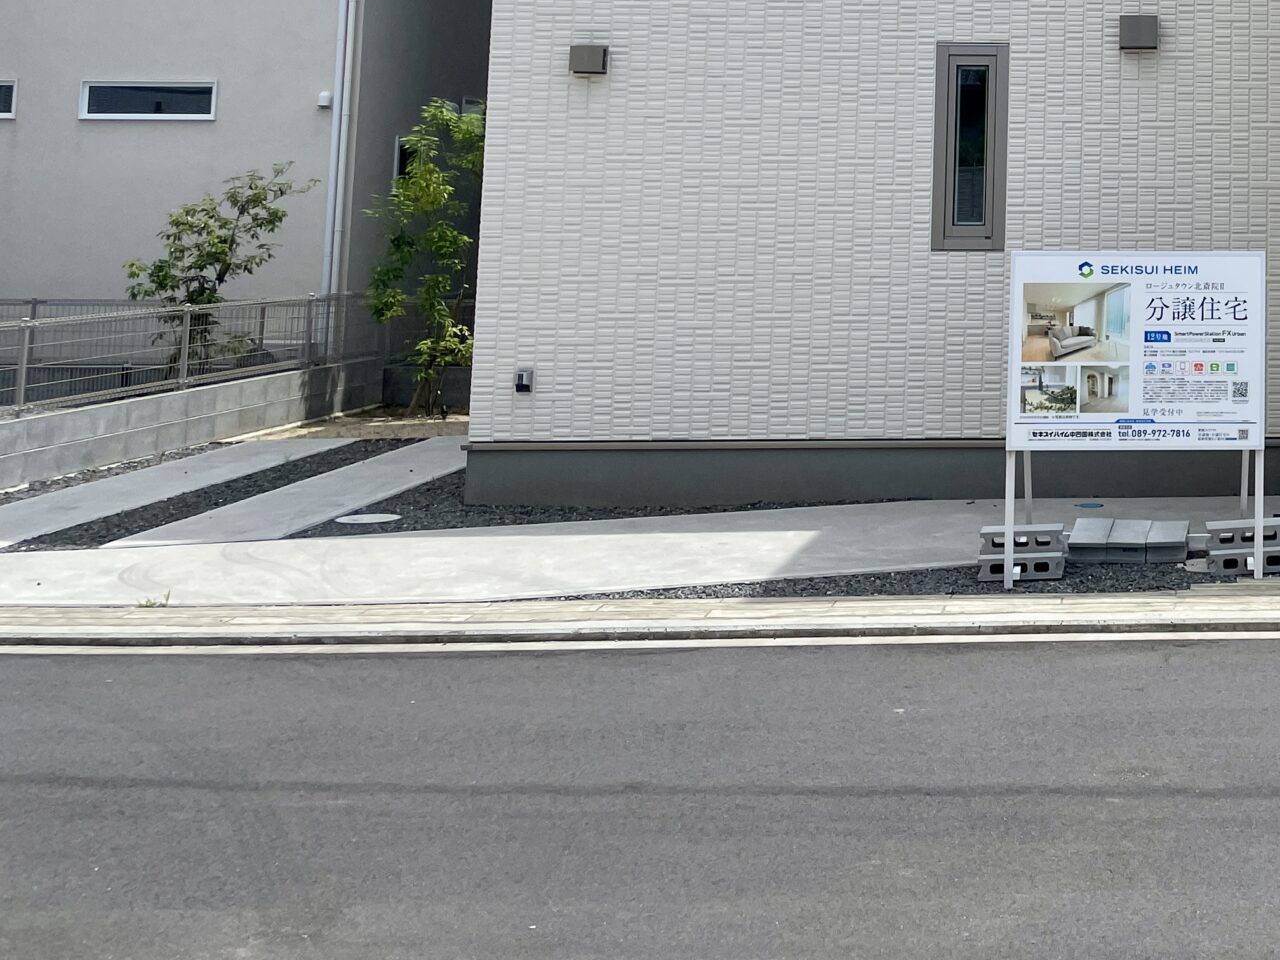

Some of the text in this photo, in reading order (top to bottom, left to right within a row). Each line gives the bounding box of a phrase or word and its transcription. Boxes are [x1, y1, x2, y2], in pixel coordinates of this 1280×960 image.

[1100, 265, 1199, 275] SEKISUI HEIM
[1145, 296, 1248, 321] 分譲住宅
